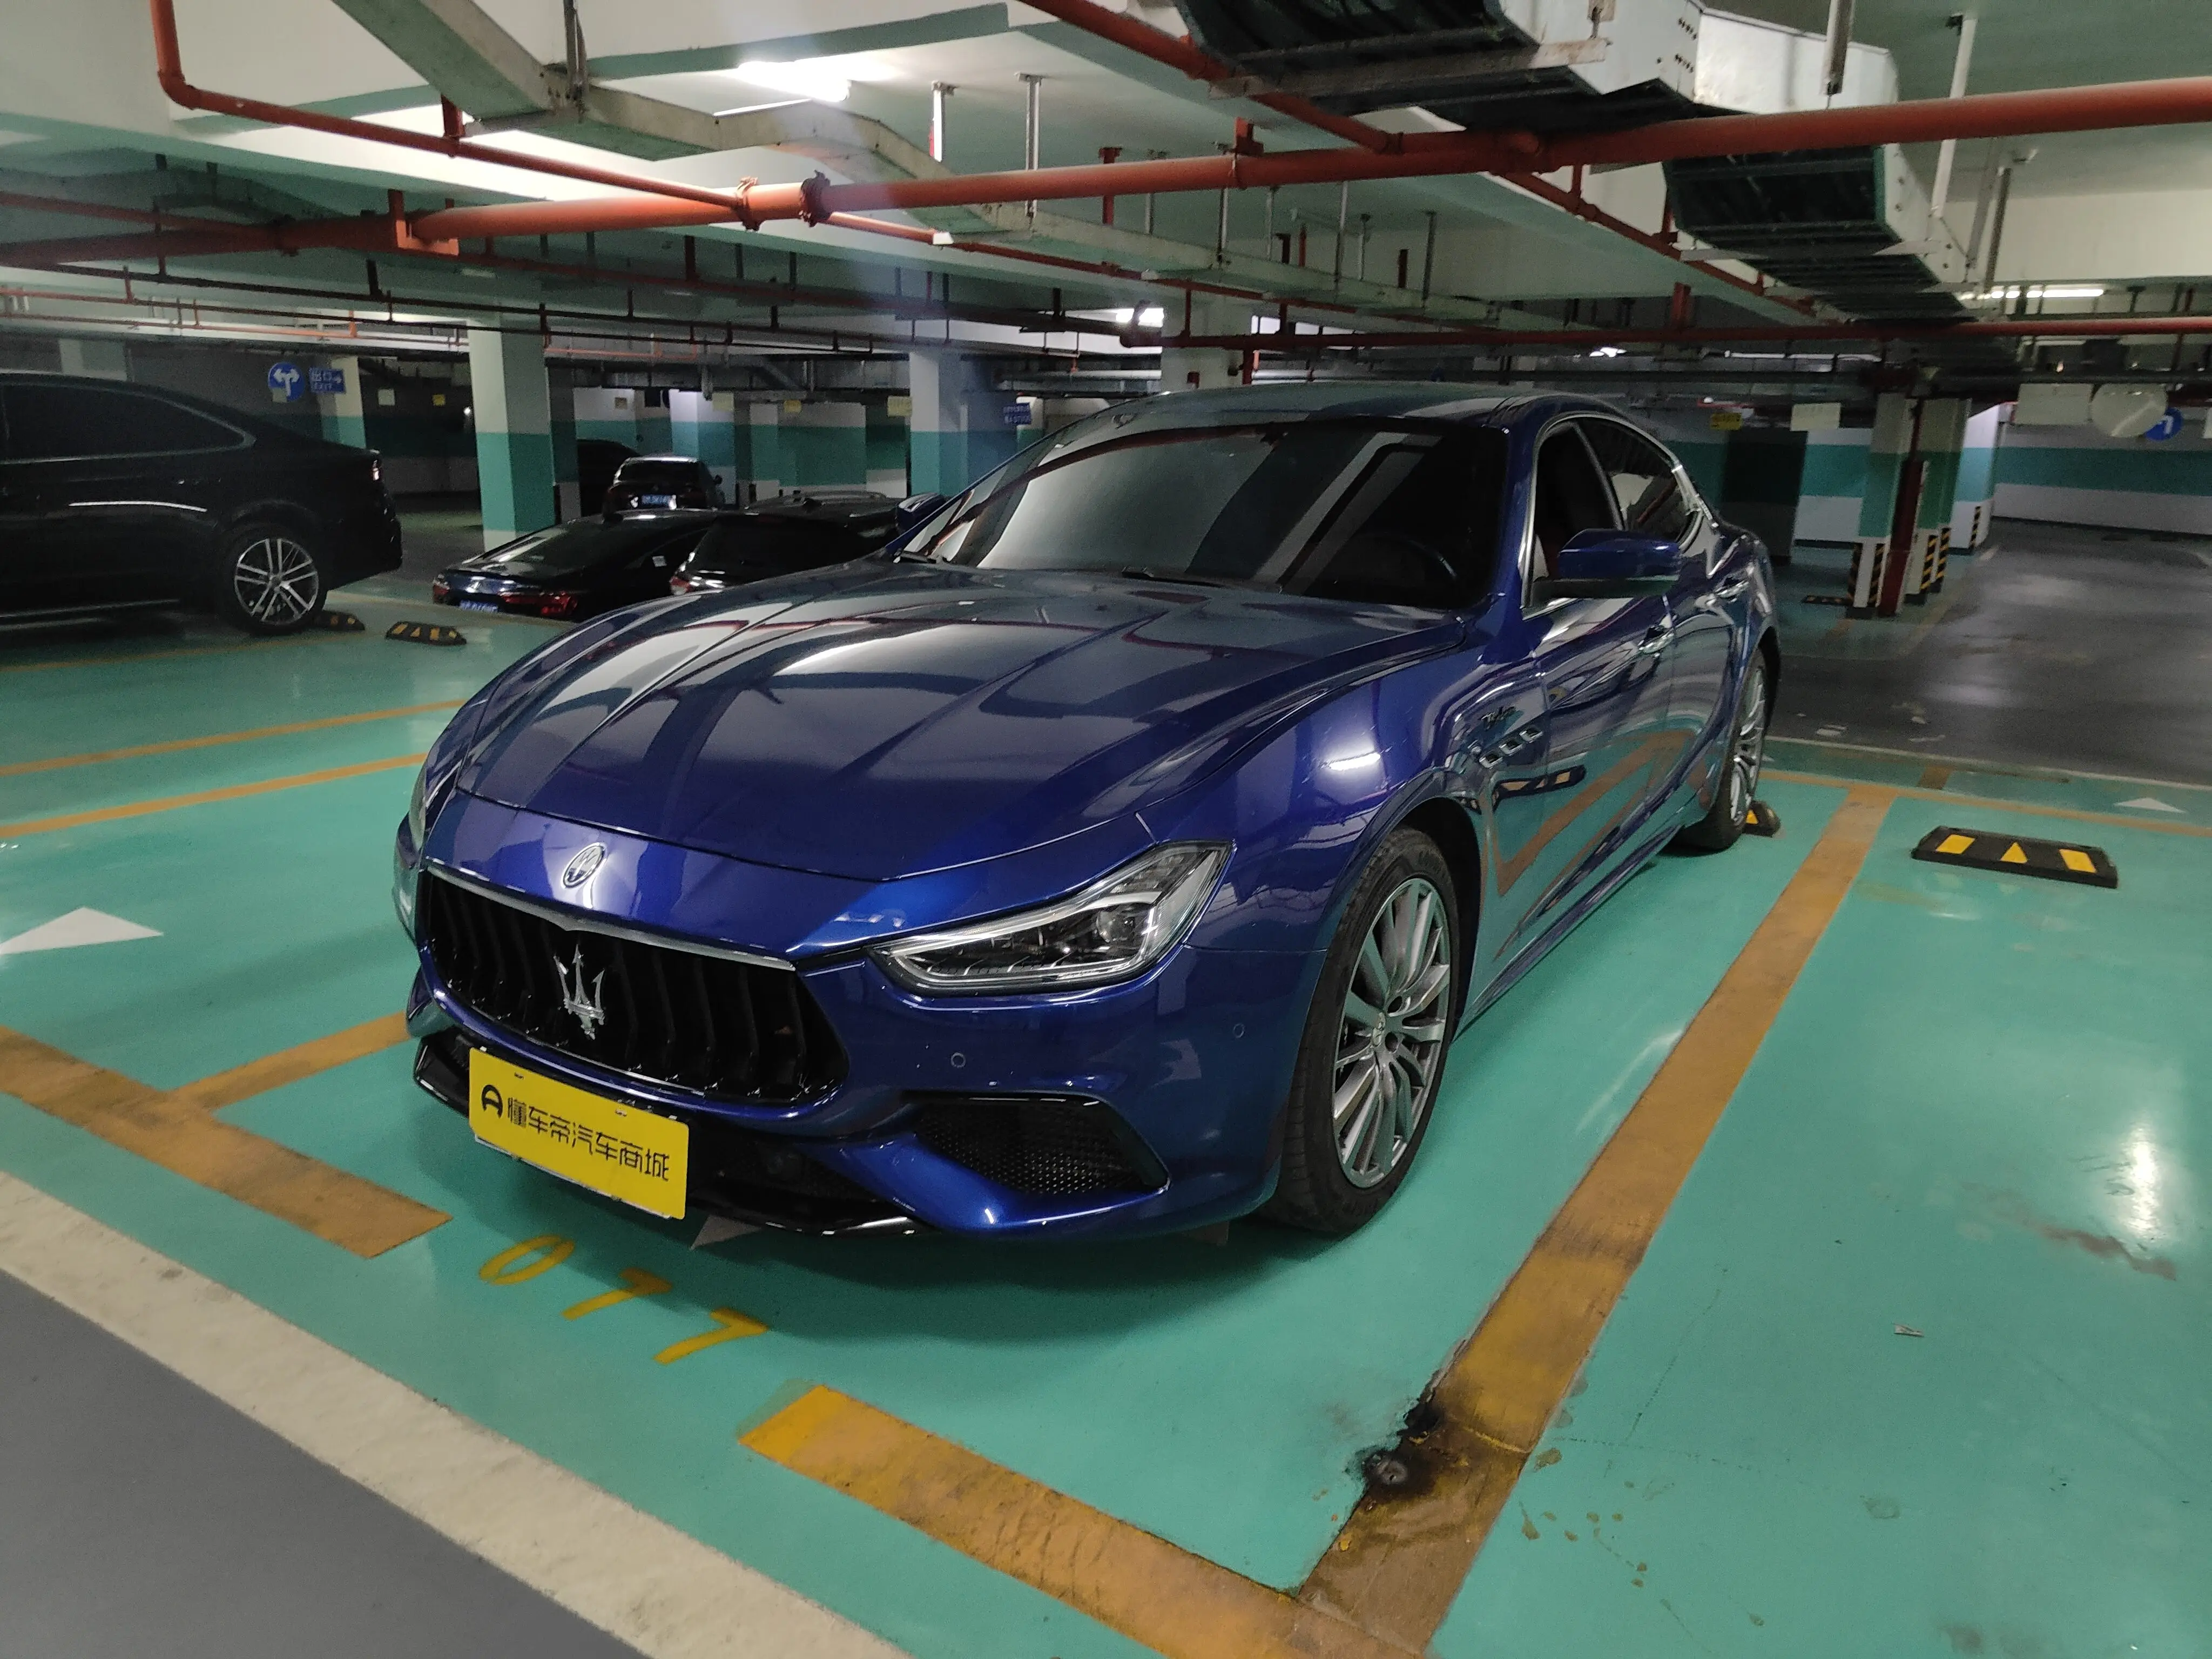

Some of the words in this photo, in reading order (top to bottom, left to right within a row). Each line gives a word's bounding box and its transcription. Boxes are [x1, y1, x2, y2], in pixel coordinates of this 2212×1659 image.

[508, 1097, 670, 1181] 懂车帝汽车商城
[479, 1235, 769, 1365] 077
